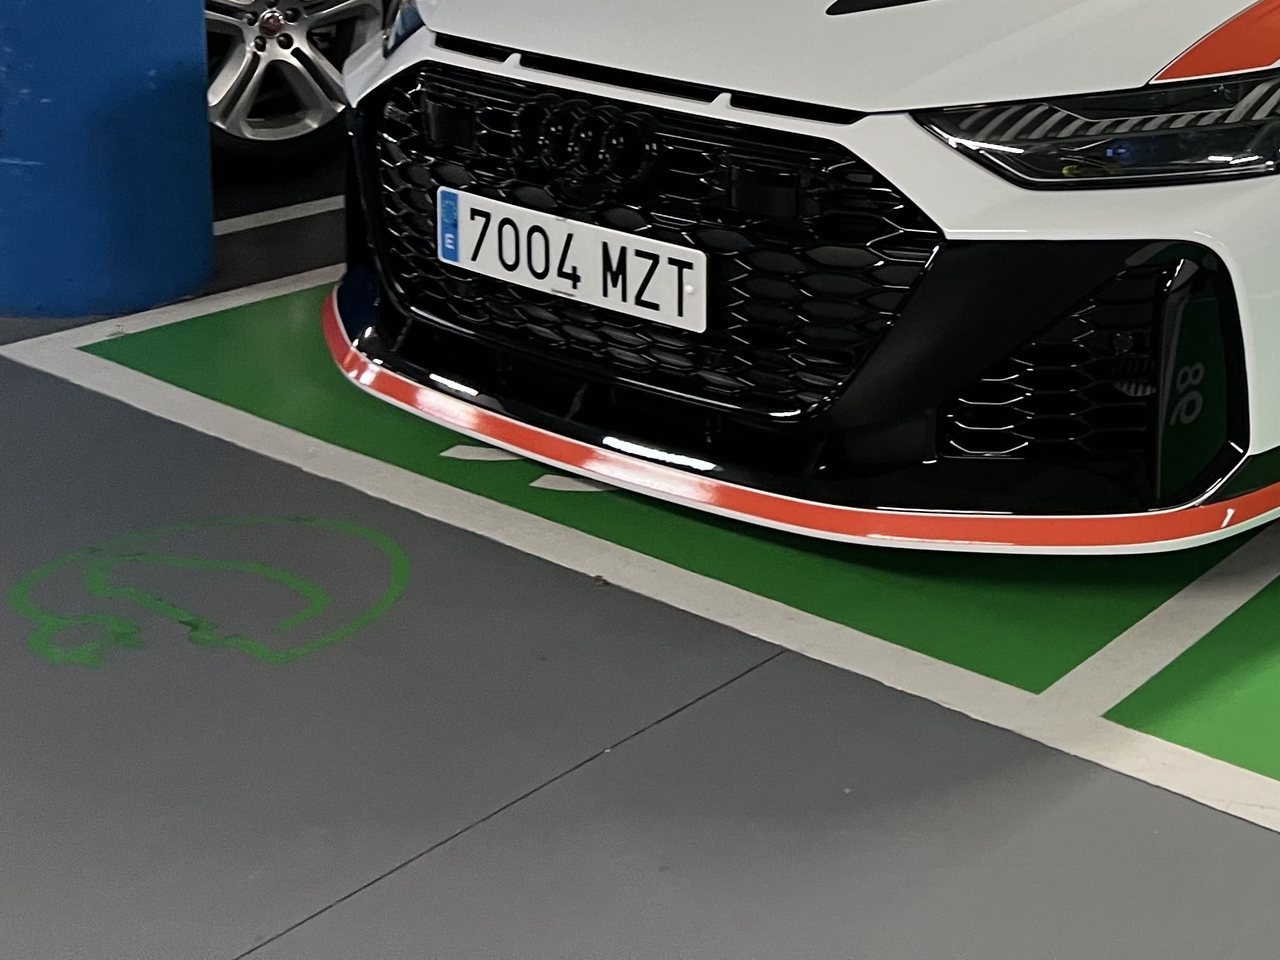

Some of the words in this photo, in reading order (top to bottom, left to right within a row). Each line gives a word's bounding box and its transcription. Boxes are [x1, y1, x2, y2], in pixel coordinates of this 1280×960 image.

[444, 233, 456, 251] E
[469, 207, 581, 290] 7004
[601, 240, 694, 318] MZT
